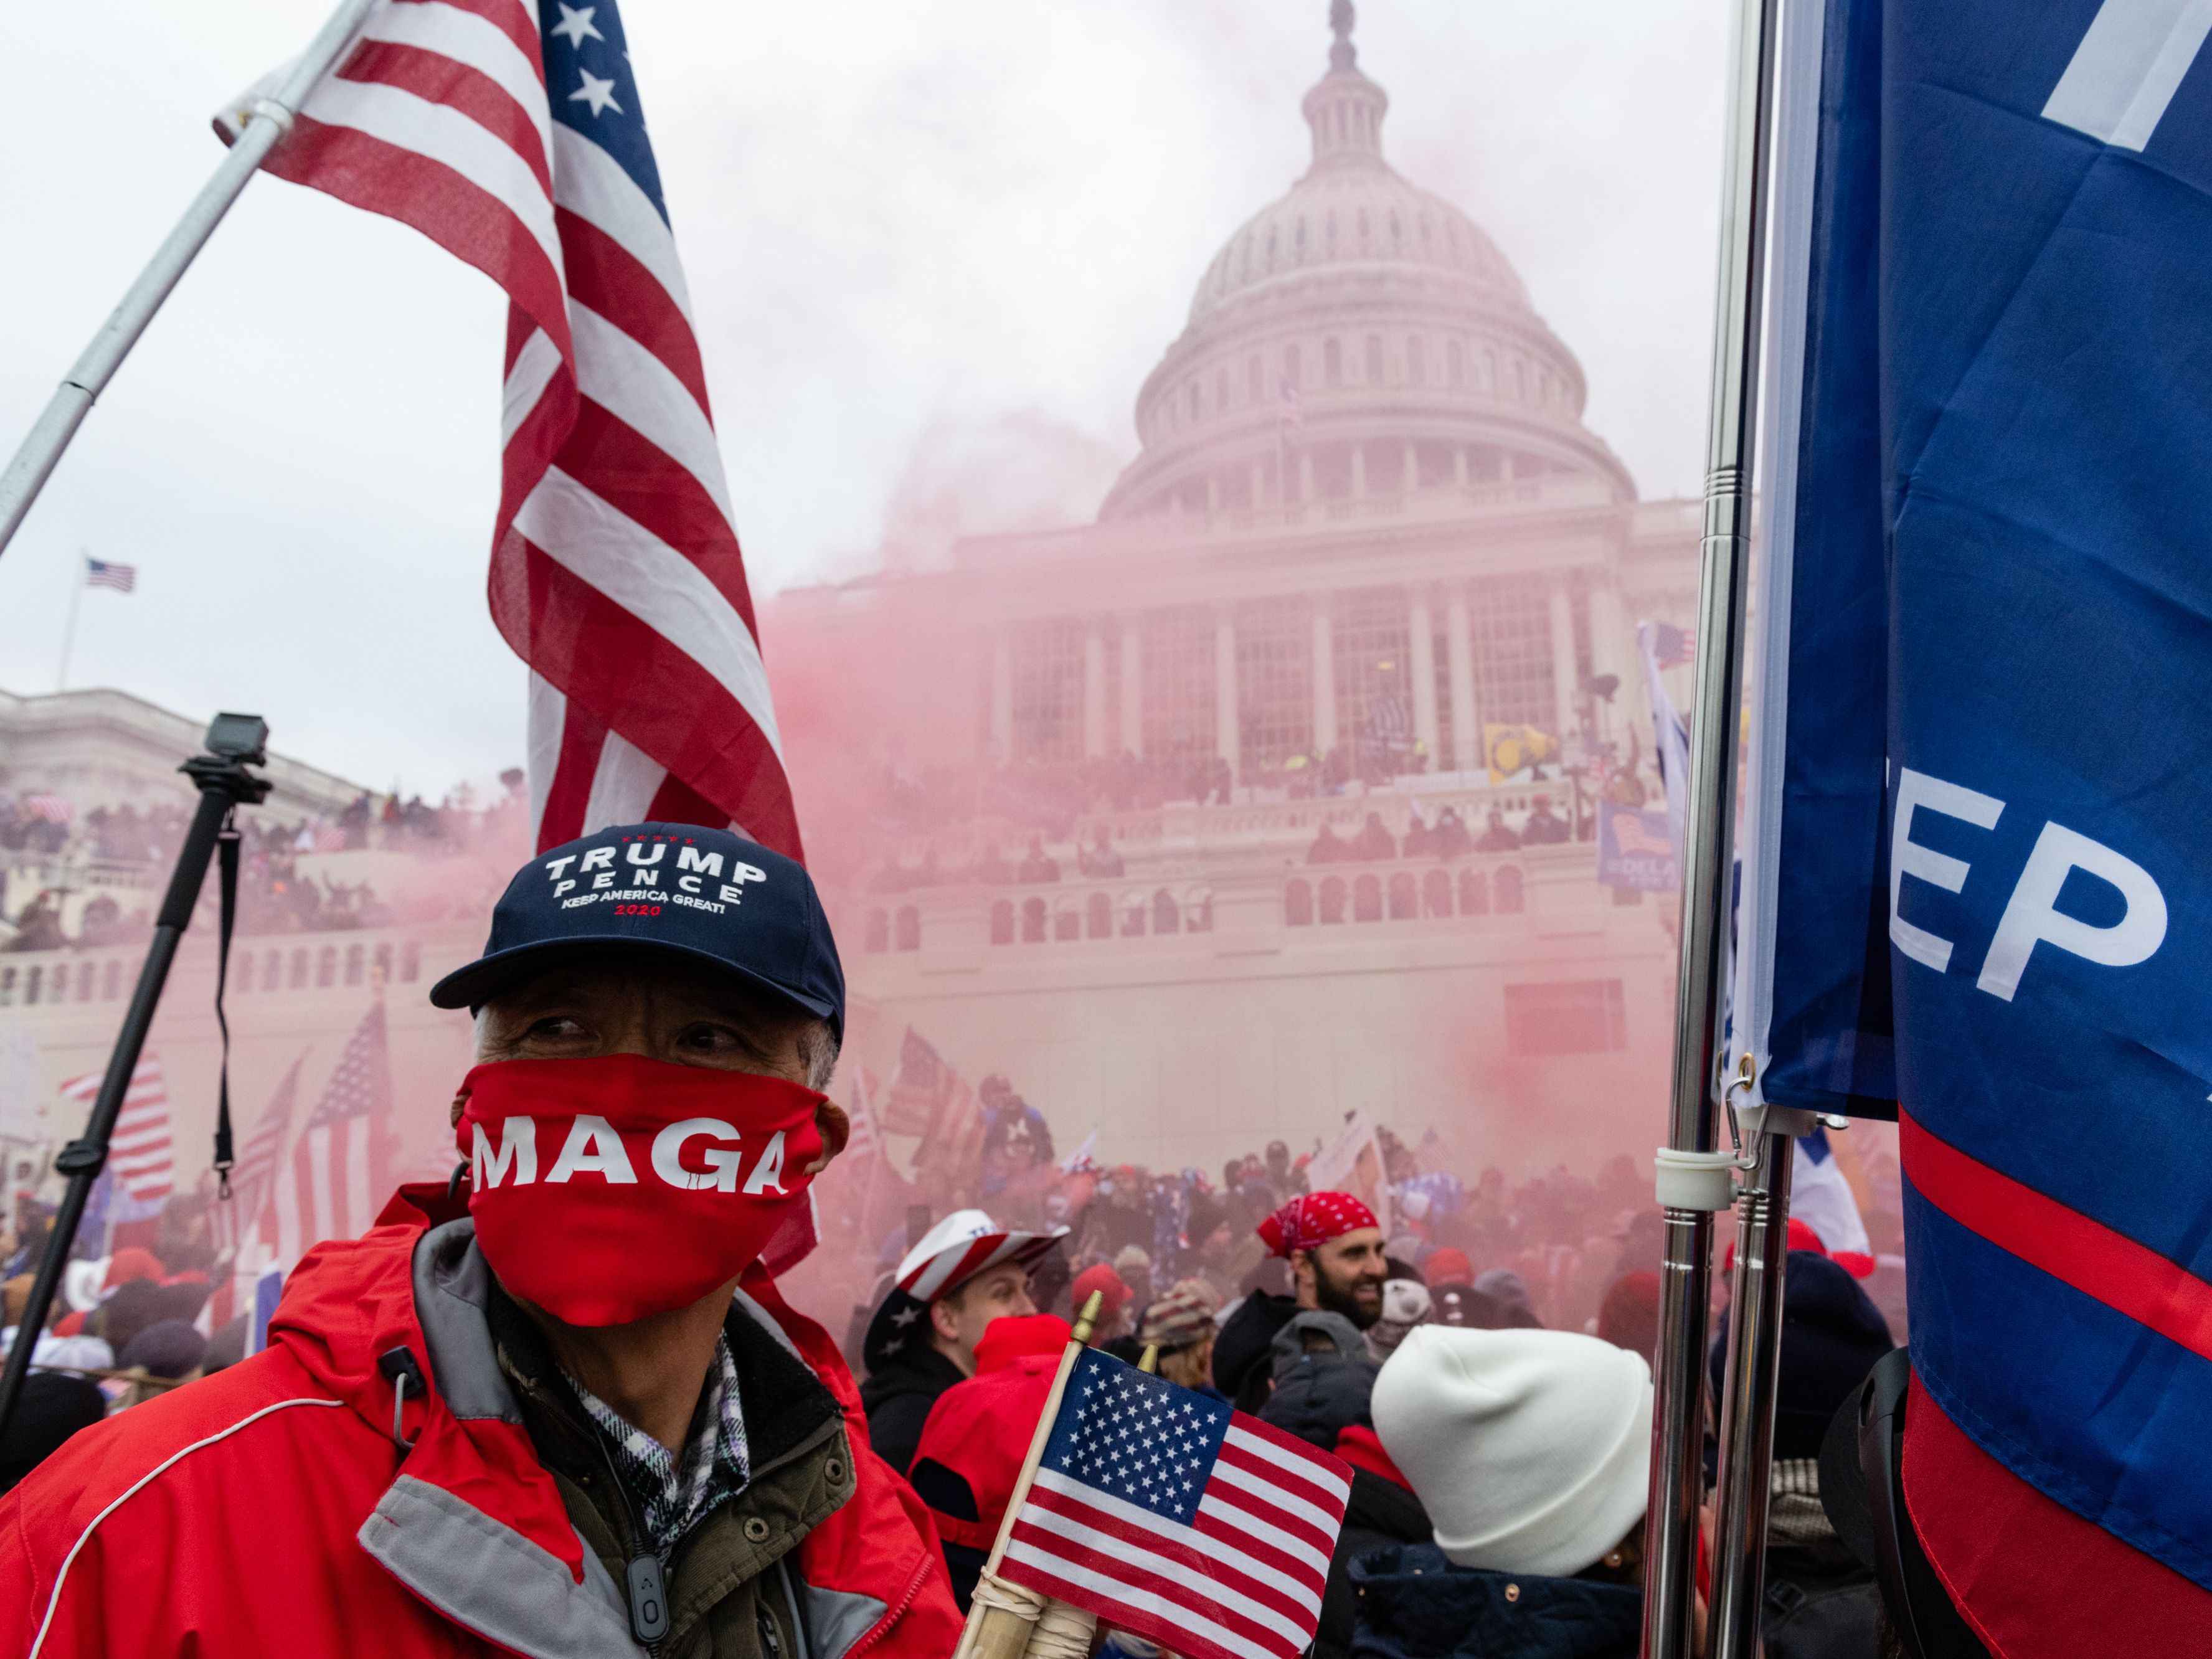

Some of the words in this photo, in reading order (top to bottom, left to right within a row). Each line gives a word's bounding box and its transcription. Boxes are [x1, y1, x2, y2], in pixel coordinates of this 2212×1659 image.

[546, 843, 767, 885] TRUMP
[1886, 757, 2168, 1002] EP
[554, 869, 743, 905] PENCE
[561, 894, 599, 909] KEEP
[600, 890, 669, 902] AMERICA
[673, 894, 726, 914] GREAT!
[614, 905, 661, 916] 2020
[472, 1114, 789, 1194] MAGA
